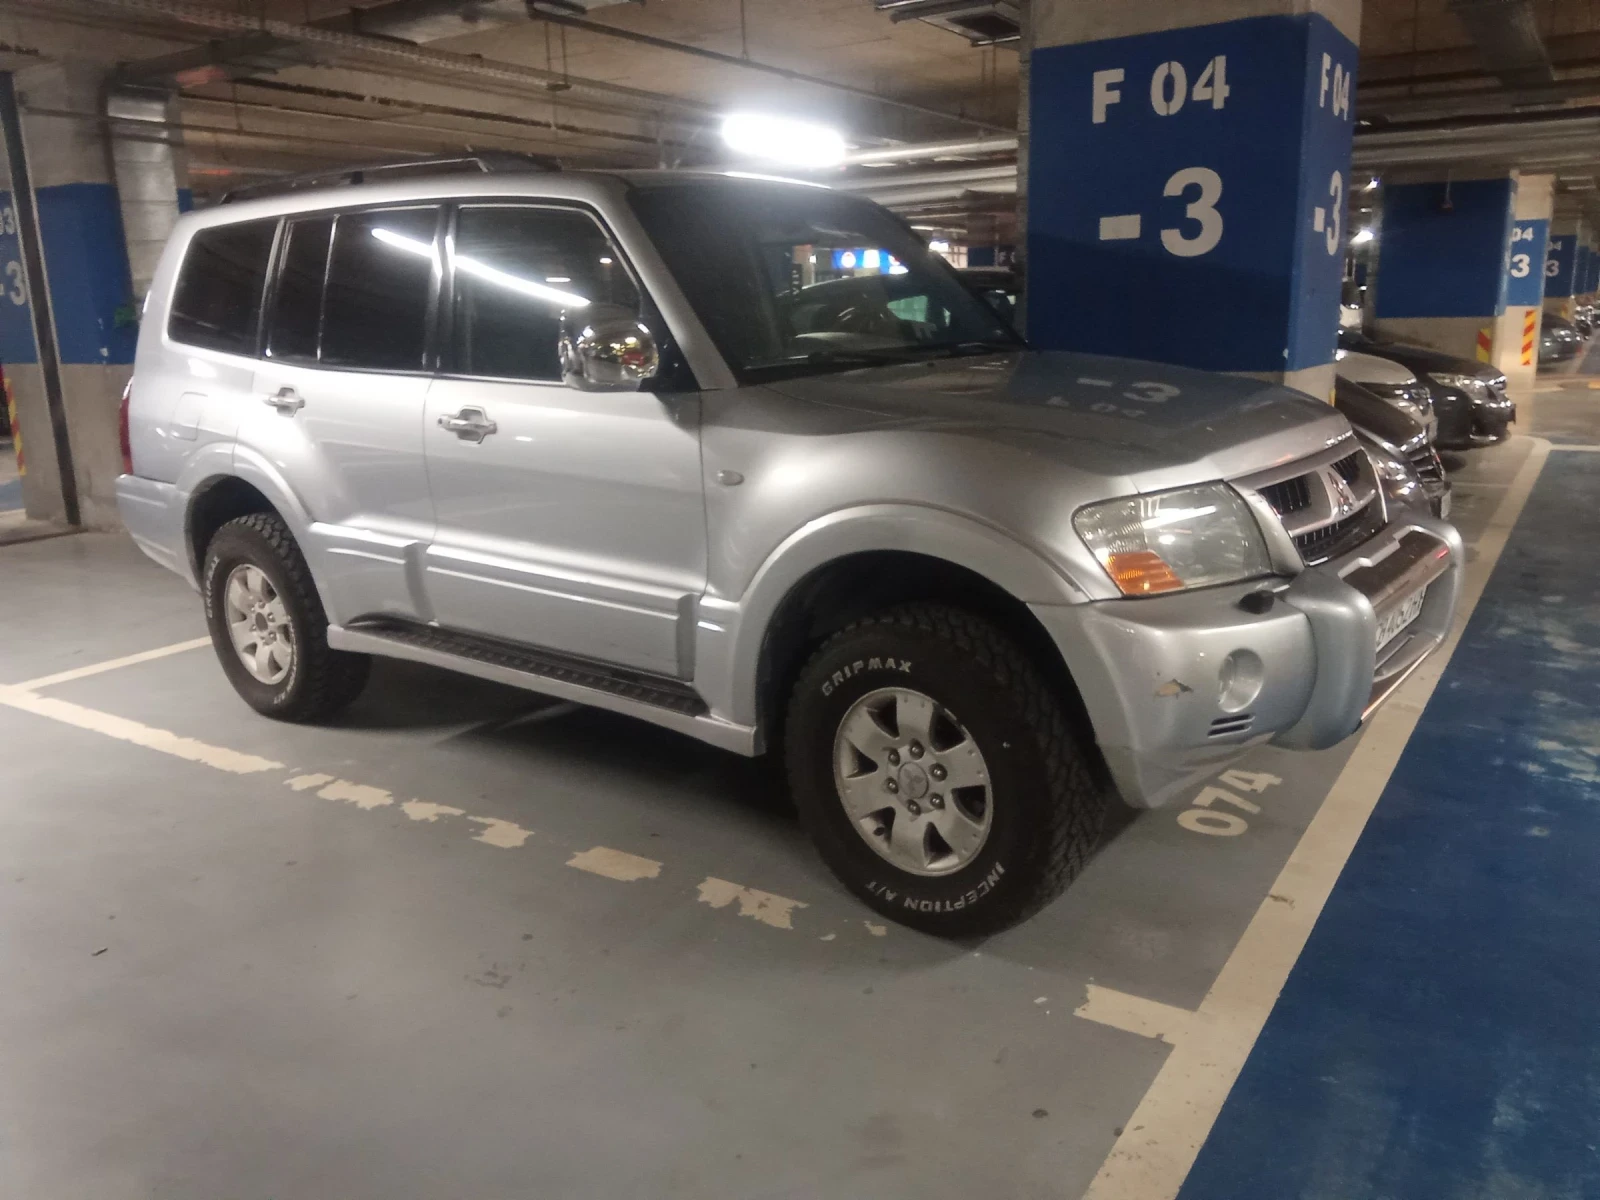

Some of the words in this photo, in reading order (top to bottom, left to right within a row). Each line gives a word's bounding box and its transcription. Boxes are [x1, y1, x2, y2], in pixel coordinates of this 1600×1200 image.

[1092, 68, 1125, 124] F
[1151, 55, 1230, 116] 04
[1320, 52, 1331, 108] F
[1333, 63, 1350, 121] 04
[821, 657, 912, 696] GRIPMAX
[1176, 769, 1283, 836] 074
[904, 861, 1006, 912] INCEPTION
